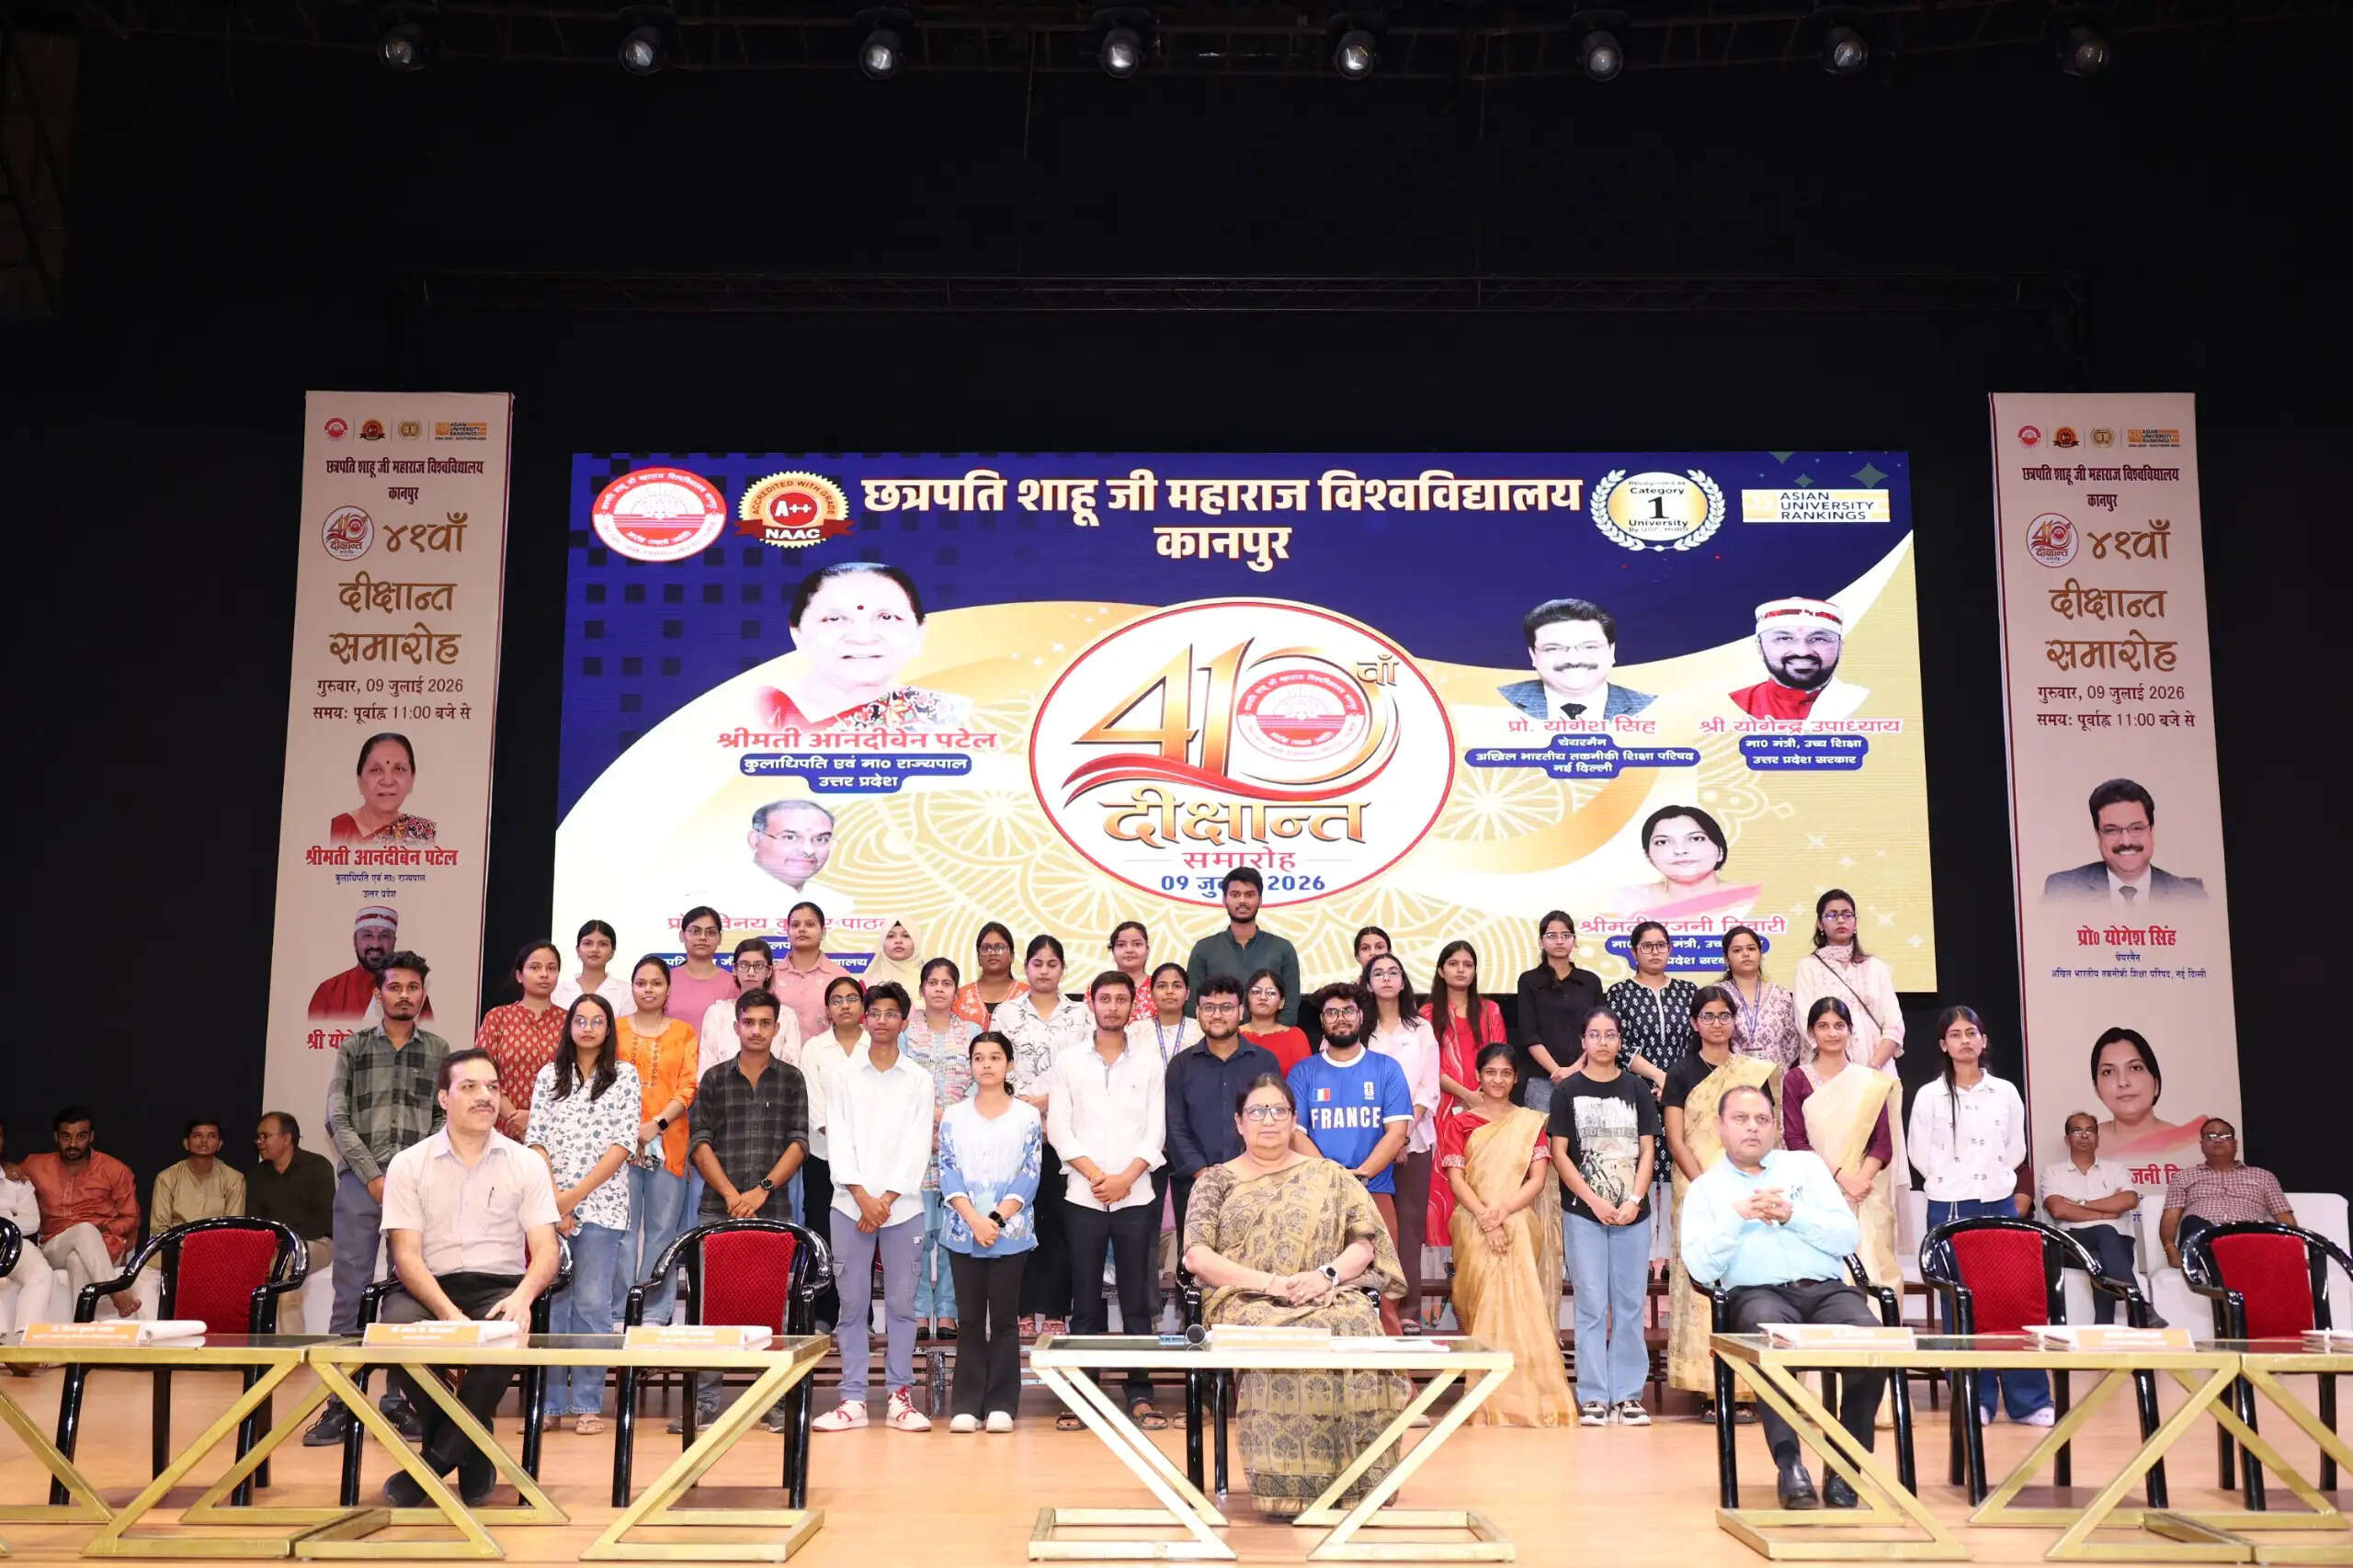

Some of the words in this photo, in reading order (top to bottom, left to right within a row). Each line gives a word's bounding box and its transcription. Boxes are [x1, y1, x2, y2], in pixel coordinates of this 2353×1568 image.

[358, 460, 376, 478] शाहू
[378, 457, 390, 474] जी
[392, 460, 425, 474] महाराज
[427, 457, 484, 474] विश्वविद्यालय
[2054, 467, 2074, 485] शाहू
[2074, 464, 2086, 481] जी
[2088, 468, 2120, 482] महाराज
[2123, 464, 2180, 482] विश्वविद्यालय
[388, 487, 419, 505] कानपुर
[753, 480, 793, 515] ACCREDITED
[797, 480, 822, 492] WITH
[860, 467, 1009, 512] छत्रपति
[1017, 478, 1100, 528] शाहू
[1105, 468, 1159, 512] जी
[1165, 478, 1311, 516] महाराज
[1317, 469, 1584, 512] विश्वविद्यालय
[1630, 487, 1685, 495] Category
[1780, 492, 1830, 501] ASIAN
[774, 500, 813, 517] A++
[1648, 496, 1670, 519] 1
[1780, 501, 1875, 511] UNIVERSITY
[2086, 494, 2118, 511] कानपुर
[1629, 519, 1689, 528] University
[1780, 511, 1867, 520] RANKINGS
[765, 528, 821, 540] NAAC
[1153, 526, 1292, 573] कानपुर
[338, 570, 458, 613] दीक्षान्त
[2048, 577, 2168, 620] दीक्षान्त
[329, 621, 462, 665] समारोह
[2044, 629, 2178, 672] समारोह
[366, 678, 384, 692] 09
[388, 676, 424, 697] जुलाई
[427, 678, 464, 692] 2026
[2087, 686, 2105, 699] 09
[2109, 683, 2144, 704] जुलाई
[2149, 686, 2185, 699] 2026
[392, 706, 431, 720] 11:00
[435, 702, 456, 720] बजे
[460, 702, 472, 720] से
[2117, 713, 2155, 727] 11:00
[2159, 710, 2181, 727] बजे
[2184, 710, 2196, 727] से
[1543, 715, 1606, 733] योगेश
[1699, 716, 1724, 733] श्री
[1733, 717, 1803, 733] योगेन्द्र
[1811, 720, 1901, 733] उपाध्याय
[716, 727, 801, 748] श्रीमती
[808, 727, 929, 750] आनंदीबेन
[936, 727, 997, 749] पटेल
[1557, 736, 1607, 747] चेयरमैन
[1831, 737, 1862, 748] शिक्षा
[744, 755, 828, 773] कुलाधिपति
[834, 755, 857, 770] एवं
[896, 758, 968, 770] राज्यपाल
[1475, 751, 1517, 762] अखिल
[1520, 751, 1566, 762] भारतीय
[1623, 750, 1654, 762] शिक्षा
[1753, 756, 1779, 765] उत्तर
[1782, 754, 1812, 766] प्रदेश
[1815, 756, 1857, 765] सरकार
[1553, 762, 1573, 774] नई
[1575, 762, 1613, 774] दिल्ली
[818, 775, 854, 788] उत्तर
[859, 774, 898, 789] प्रदेश
[1097, 785, 1372, 848] दीक्षान्त
[305, 846, 350, 866] श्रीमती
[425, 846, 459, 866] पटेल
[1182, 846, 1297, 870] समारोह
[1161, 875, 1189, 891] 09
[1267, 875, 1325, 891] 2026
[2103, 925, 2146, 947] योगेश
[2149, 925, 2177, 947] सिंह
[307, 1029, 325, 1050] श्री
[1311, 1106, 1381, 1130] FRANCE
